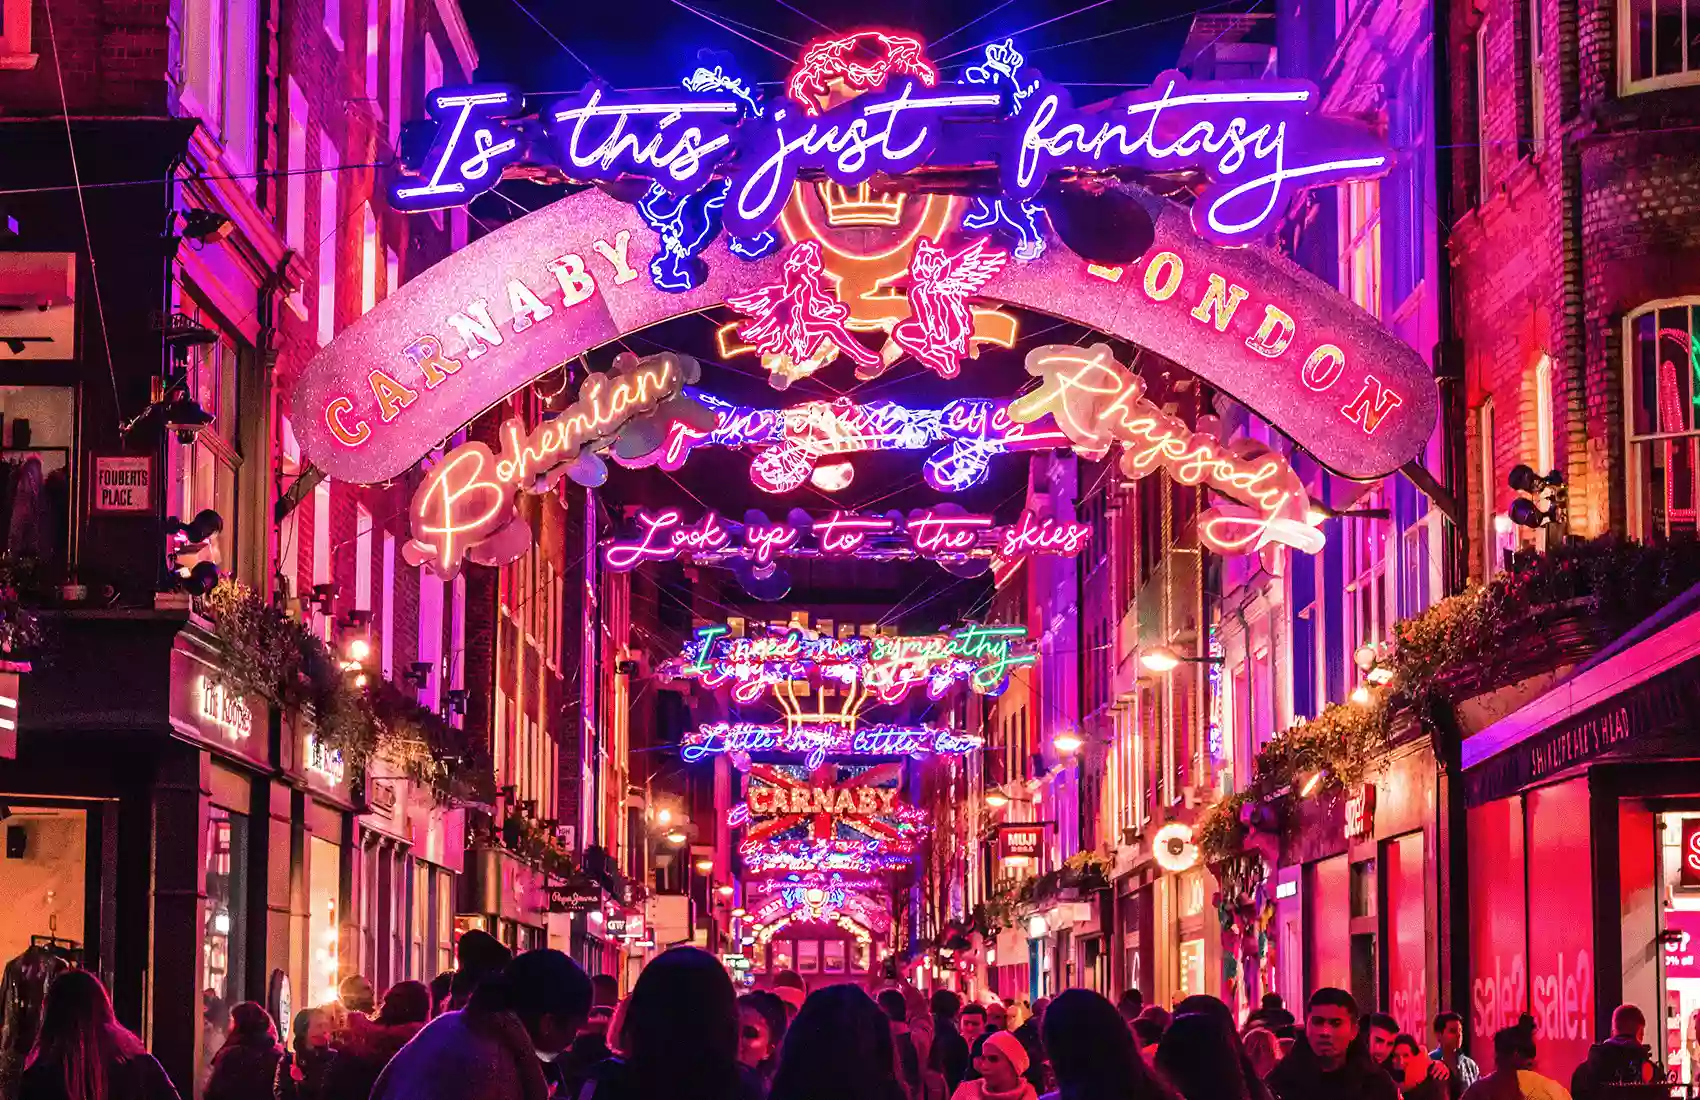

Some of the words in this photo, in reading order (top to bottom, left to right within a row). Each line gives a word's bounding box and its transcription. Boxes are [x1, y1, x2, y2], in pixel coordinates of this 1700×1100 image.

[397, 92, 516, 199] Is
[555, 89, 738, 182] this
[736, 82, 1001, 221] just
[1017, 80, 1386, 235] fantasy
[324, 229, 639, 447] CARNABY
[1087, 251, 1402, 434] ONDON
[99, 469, 149, 487] FOUBERTS
[419, 361, 671, 569] Bohemian
[1019, 354, 1315, 548] Rhapsody
[102, 489, 133, 506] PLACE
[605, 511, 726, 567] Look
[748, 526, 798, 562] up
[812, 511, 892, 551] to
[907, 512, 991, 552] the
[1003, 513, 1088, 556] skies
[684, 628, 727, 675] I
[872, 624, 1037, 688] sympathy
[1601, 707, 1630, 745] HEAD
[750, 786, 898, 813] CARNABY
[1007, 832, 1037, 846] MUJI
[1474, 952, 1524, 1041] sale?
[1533, 948, 1590, 1041] sale?
